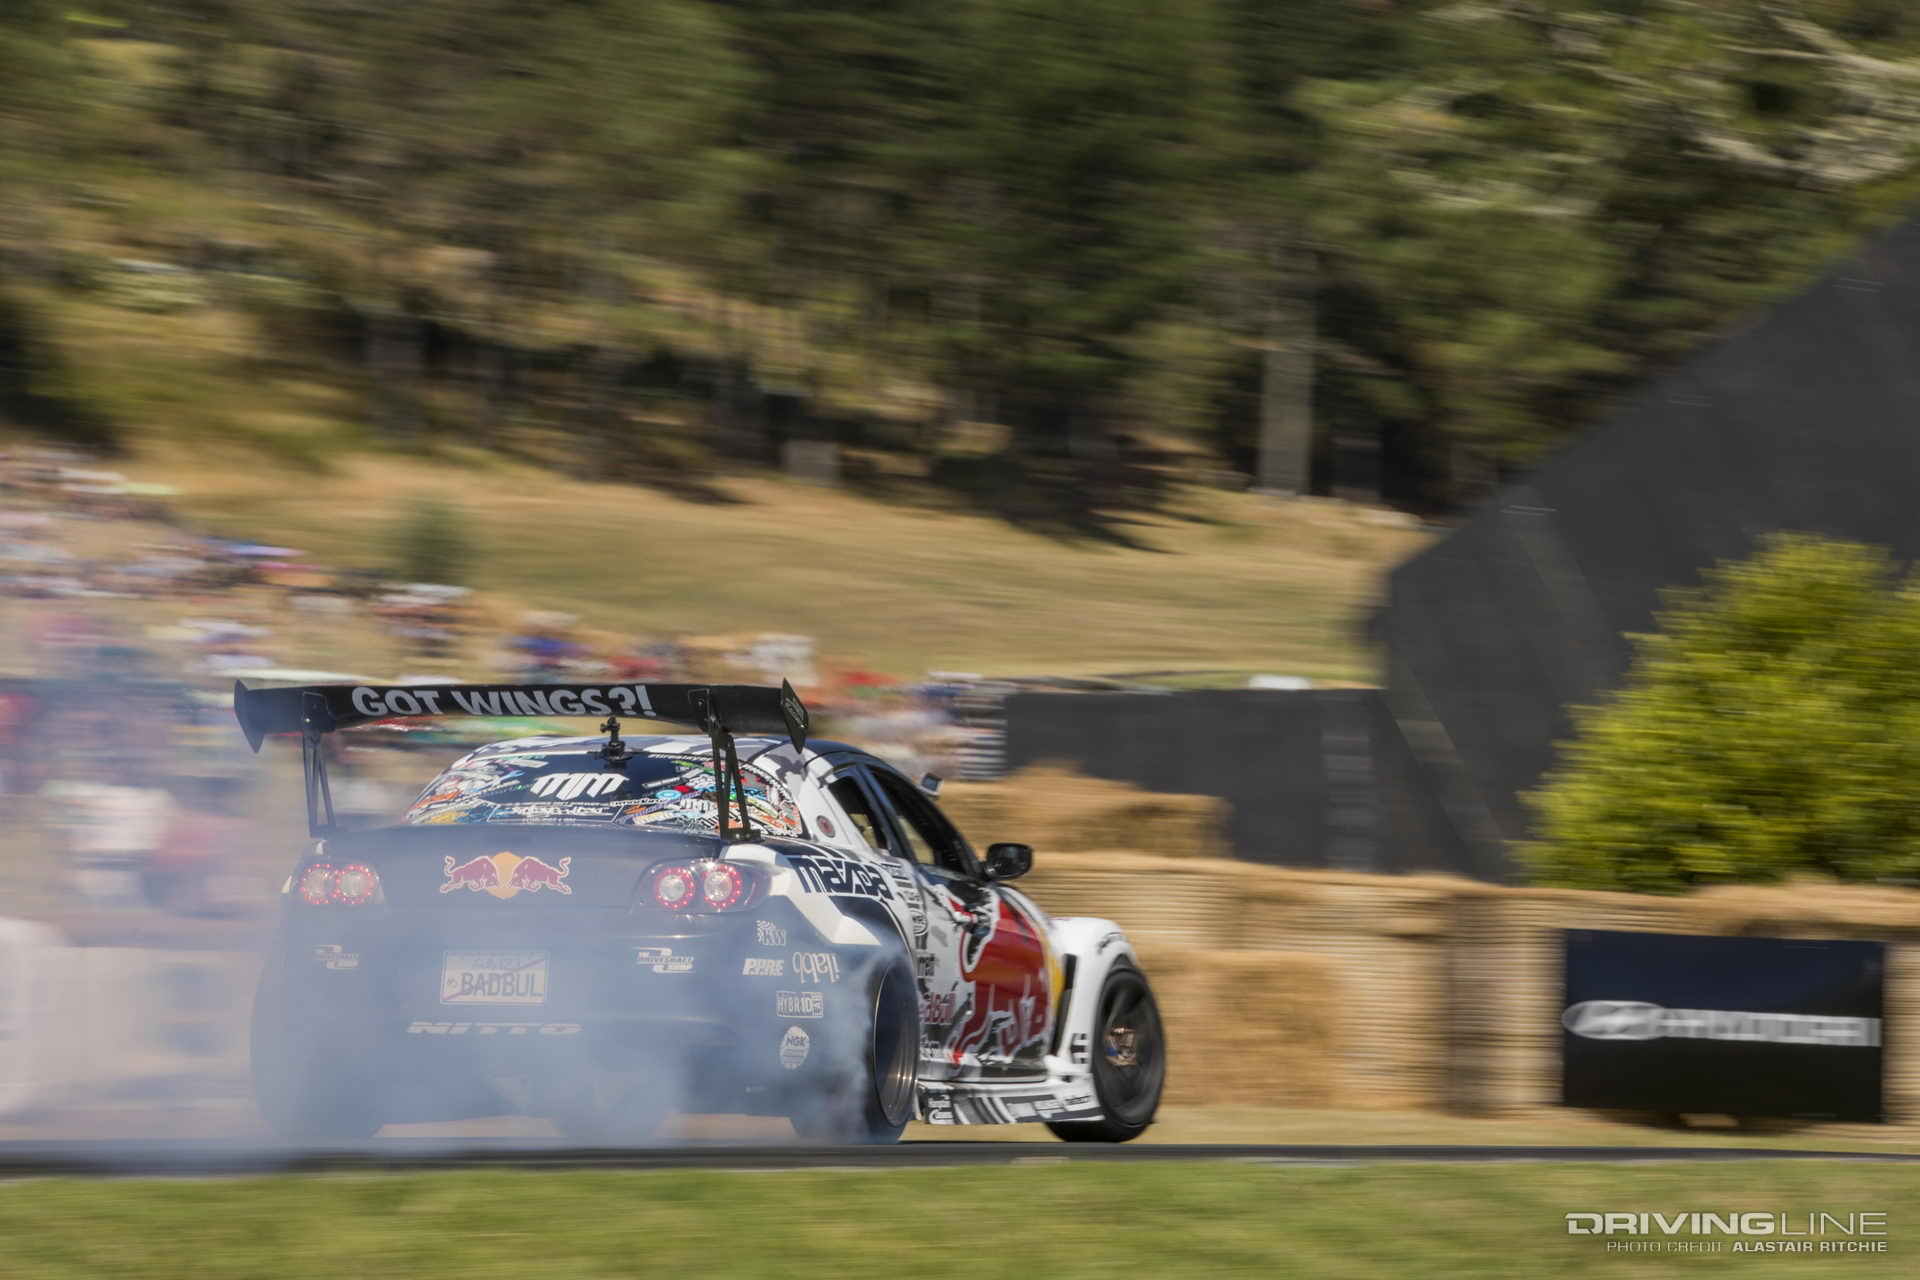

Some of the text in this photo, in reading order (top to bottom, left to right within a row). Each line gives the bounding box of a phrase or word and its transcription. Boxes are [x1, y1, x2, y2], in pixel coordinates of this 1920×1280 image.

[351, 685, 657, 717] GOT WINGS?!
[762, 928, 787, 947] KW
[460, 972, 543, 998] BADBUL
[778, 996, 813, 1013] HYBRID
[406, 1021, 582, 1035] NITTO
[785, 1036, 807, 1048] NGK
